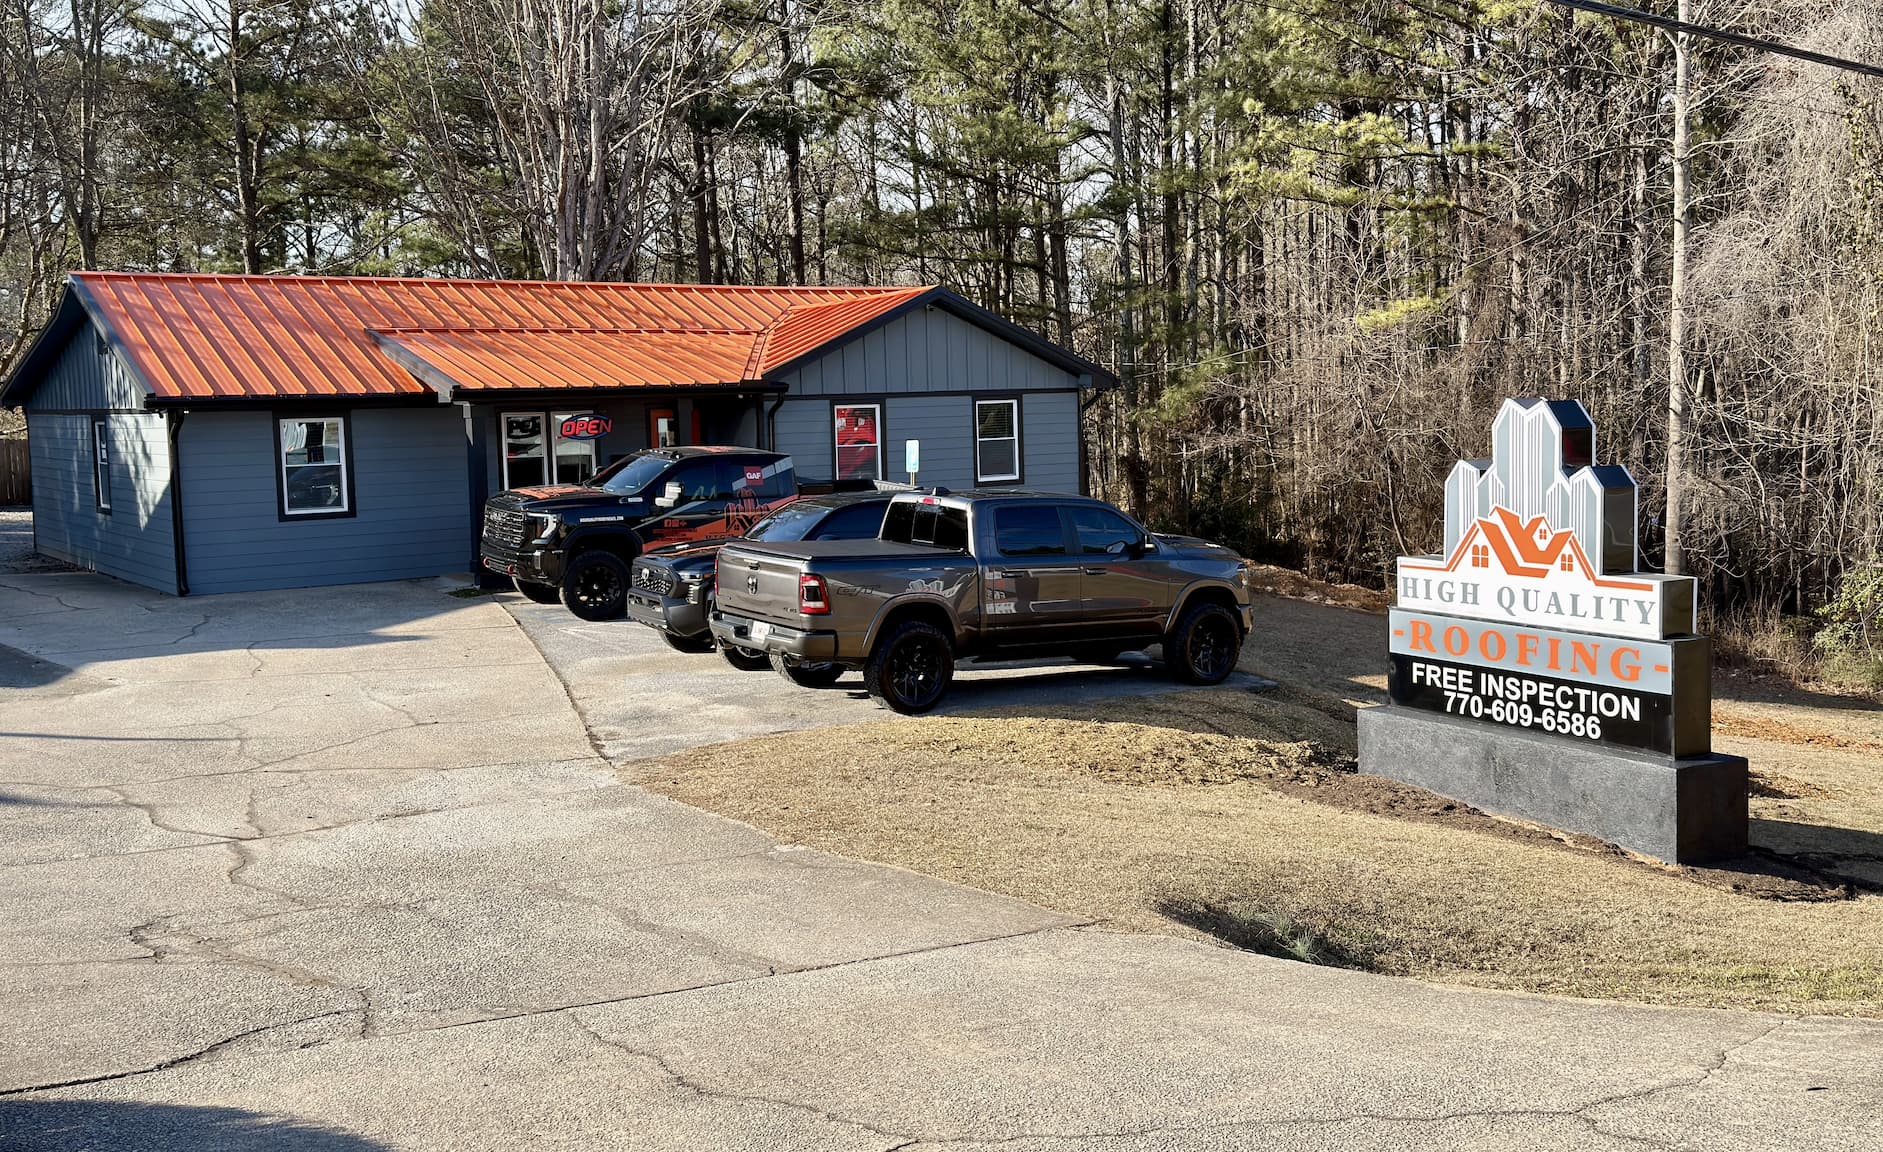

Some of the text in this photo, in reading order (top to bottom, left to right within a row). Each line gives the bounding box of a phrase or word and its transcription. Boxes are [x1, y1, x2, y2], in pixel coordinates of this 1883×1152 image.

[561, 419, 613, 436] OPEN
[1401, 577, 1656, 625] HIGH QUALITY
[1412, 663, 1641, 722] FREE INSPECTION
[1444, 690, 1601, 740] 770-609-6586
